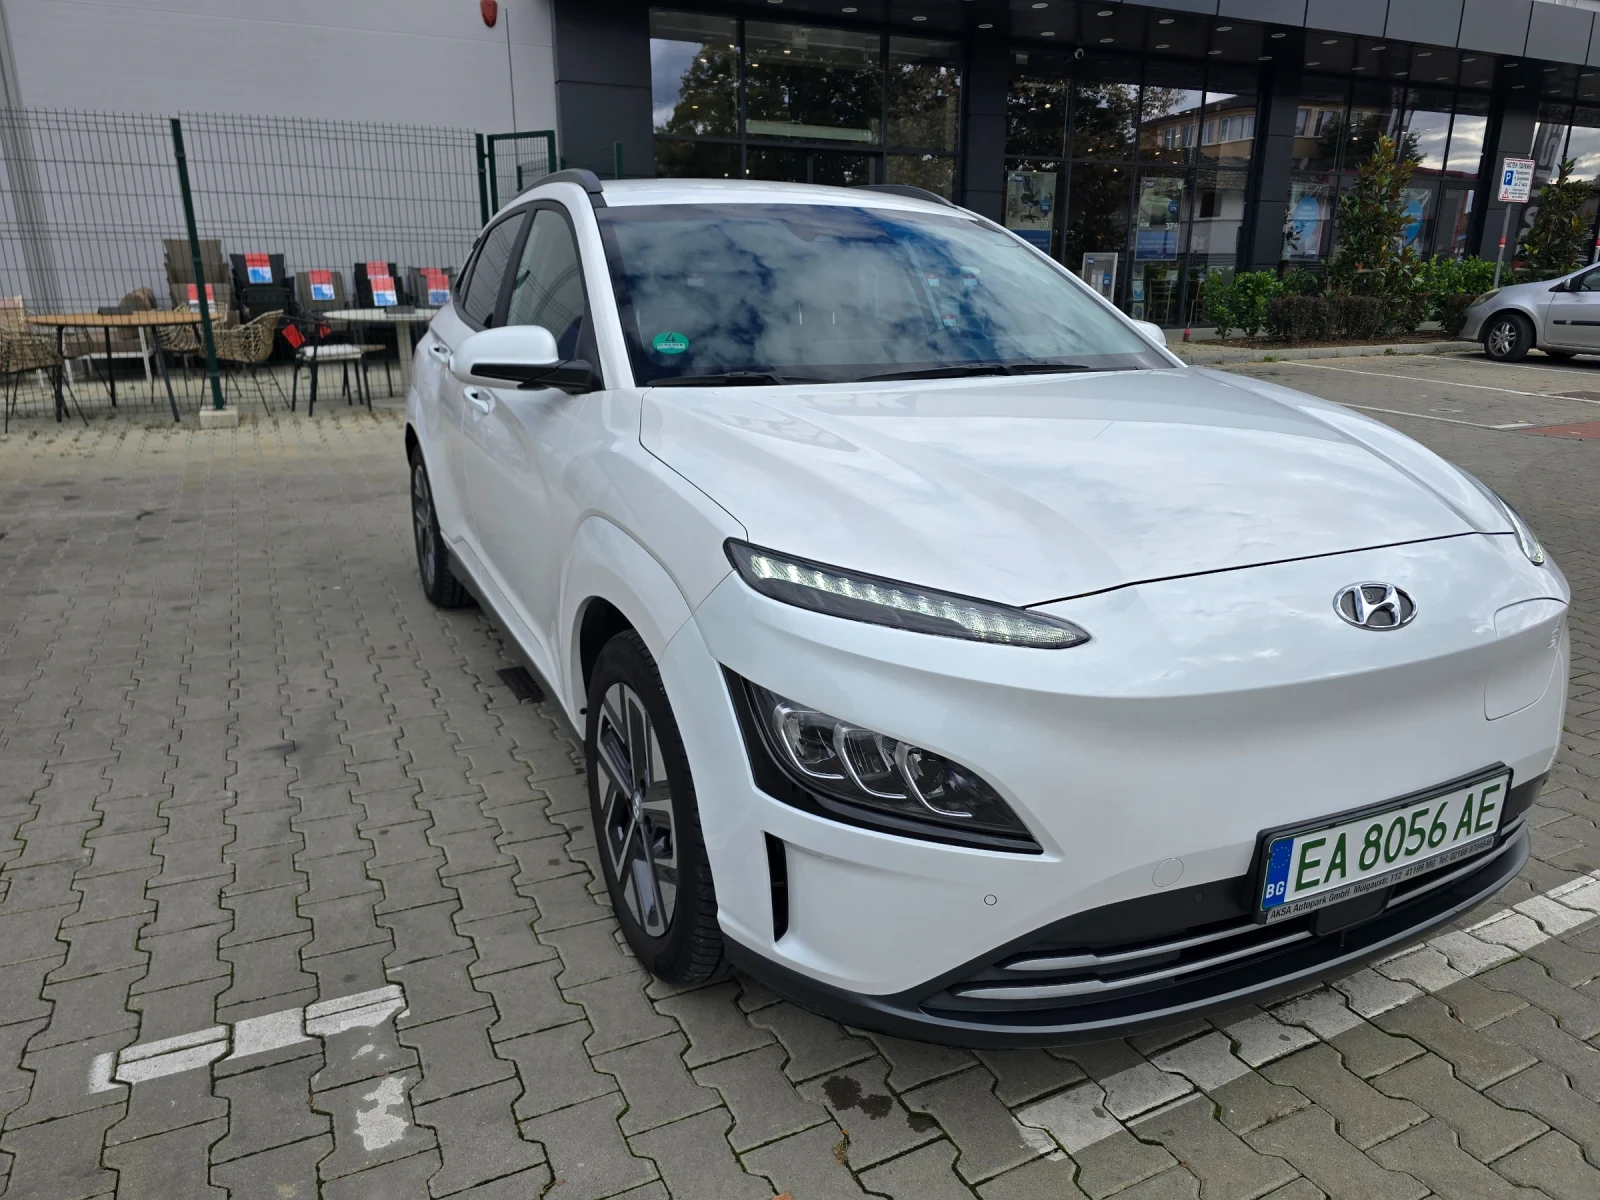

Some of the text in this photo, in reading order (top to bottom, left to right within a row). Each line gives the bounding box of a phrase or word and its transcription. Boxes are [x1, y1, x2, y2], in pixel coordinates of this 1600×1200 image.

[1294, 783, 1501, 892] EA 8056 AE
[1265, 881, 1285, 898] BG
[1270, 906, 1292, 919] AKSA
[1293, 896, 1327, 913] Autopark
[1328, 889, 1350, 902] GmbH
[1390, 871, 1403, 882] 112
[1405, 863, 1425, 877] 41199
[1425, 859, 1436, 870] MG
[1438, 854, 1450, 865] Tel:
